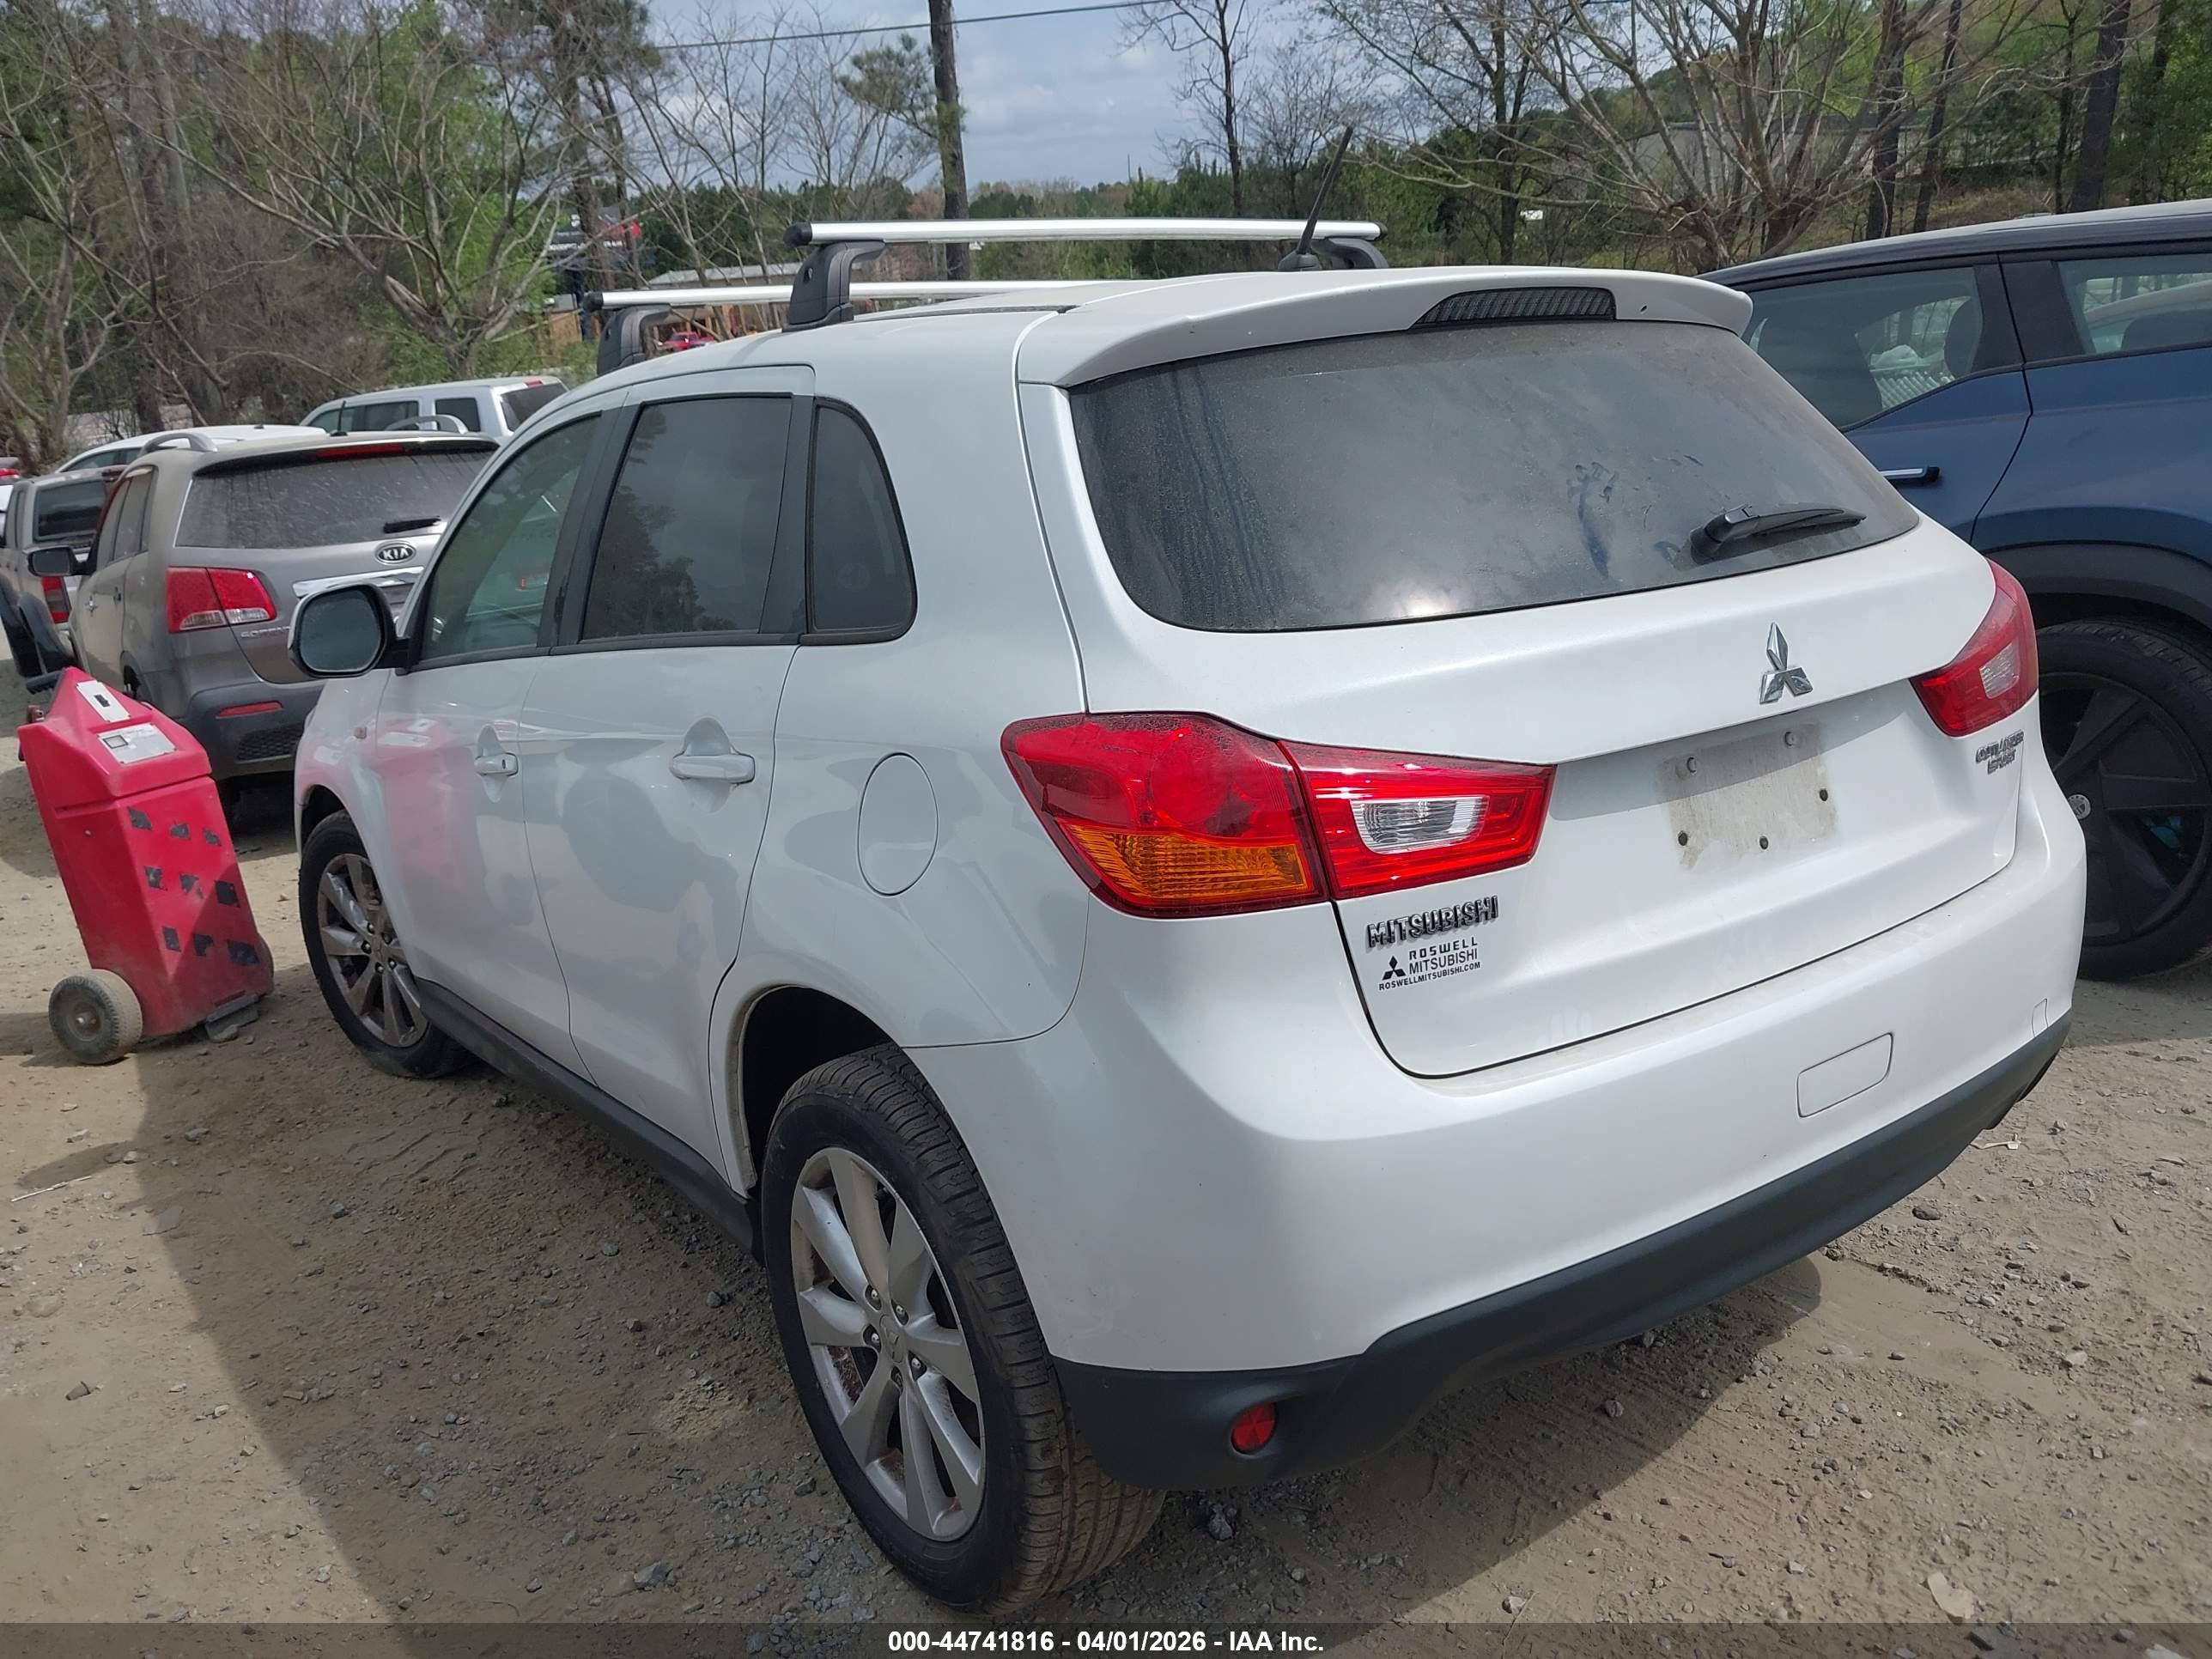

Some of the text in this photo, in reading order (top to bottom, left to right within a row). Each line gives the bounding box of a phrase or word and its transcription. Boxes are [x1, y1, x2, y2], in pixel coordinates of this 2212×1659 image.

[383, 548, 409, 560] KIA
[1366, 896, 1499, 949] MITSUBISHI
[1408, 936, 1478, 961] ROSWELL
[1409, 947, 1478, 975] MITSUBISHI
[1378, 961, 1480, 991] ROSWELLMITSUBISHI.COM
